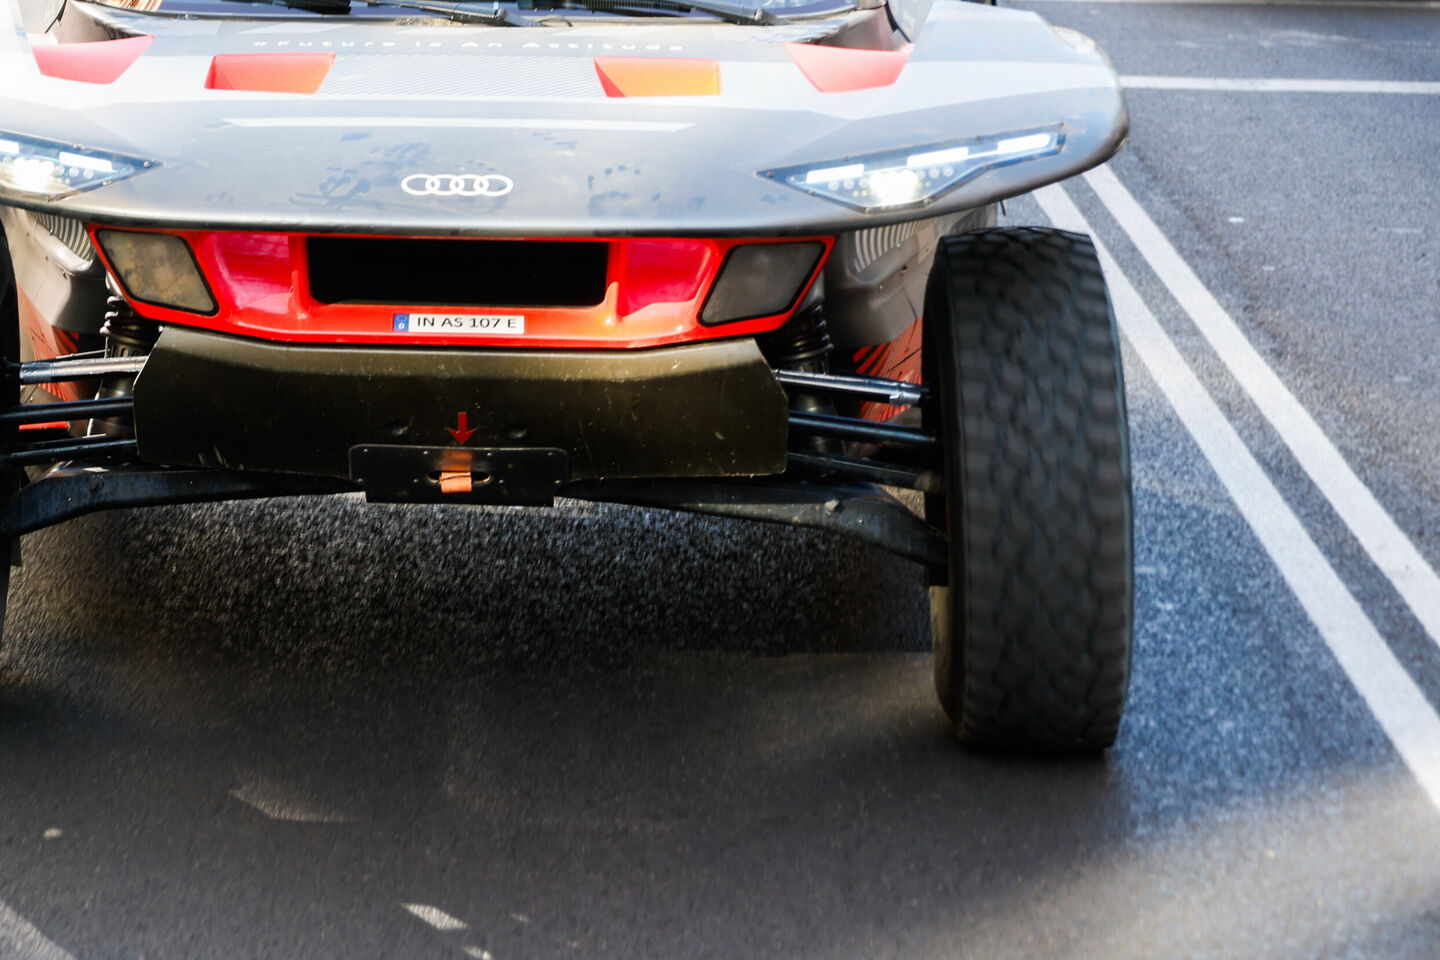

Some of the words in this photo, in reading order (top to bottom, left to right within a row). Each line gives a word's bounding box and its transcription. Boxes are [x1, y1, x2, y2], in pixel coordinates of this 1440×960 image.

[417, 317, 435, 327] IN
[441, 317, 464, 328] AS
[469, 317, 501, 328] 107
[507, 318, 517, 328] E
